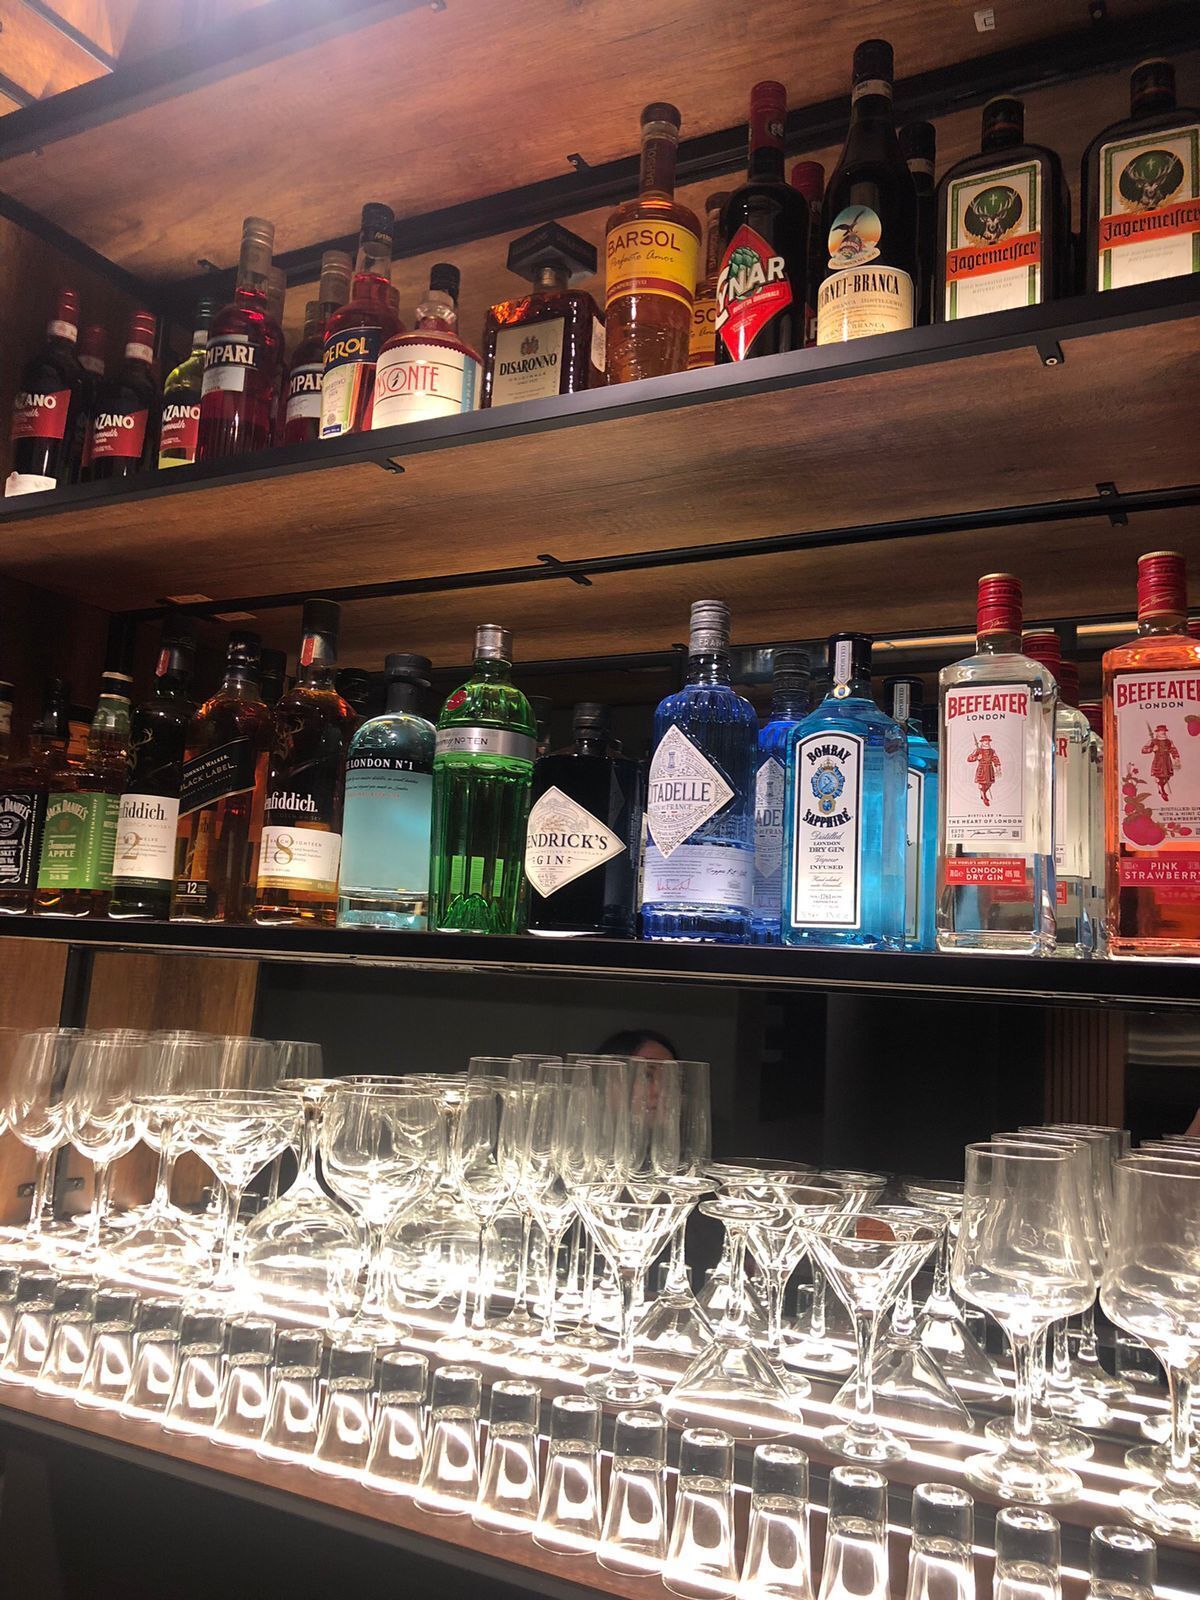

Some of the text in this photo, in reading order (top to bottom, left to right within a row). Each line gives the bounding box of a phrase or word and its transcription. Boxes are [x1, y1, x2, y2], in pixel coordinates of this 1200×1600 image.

[608, 230, 681, 258] BARSOL
[499, 352, 558, 376] DISARONNO
[947, 692, 1027, 720] BEEFEATER
[1139, 701, 1184, 710] LONDON
[966, 713, 1006, 721] LONDON
[351, 757, 391, 769] LONDON
[806, 744, 852, 766] BOMBAY
[802, 807, 852, 829] SAPPHIRE
[262, 834, 295, 866] 18
[536, 855, 564, 865] GIN
[1151, 862, 1178, 870] PINK
[187, 882, 197, 894] 12
